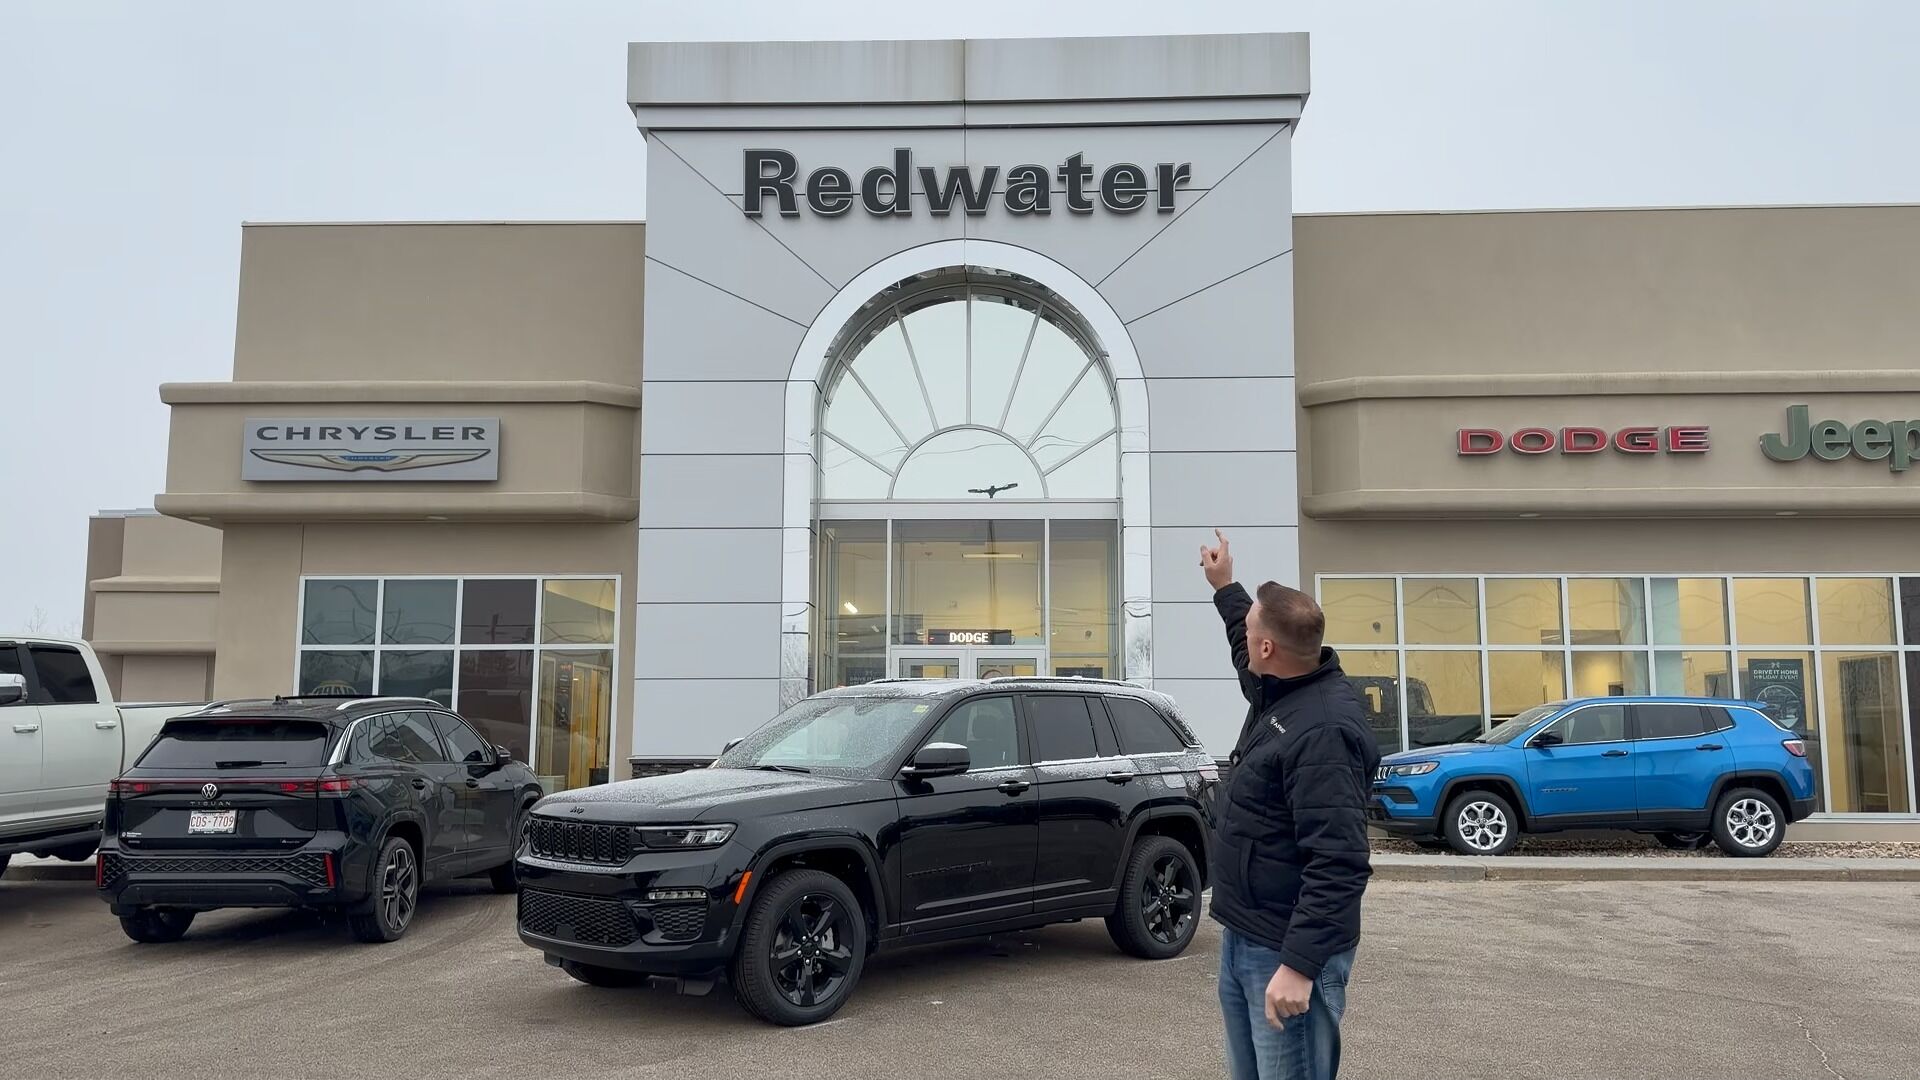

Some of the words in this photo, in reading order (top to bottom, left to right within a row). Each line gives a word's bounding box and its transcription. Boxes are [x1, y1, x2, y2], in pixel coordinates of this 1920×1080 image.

[743, 148, 1191, 217] Redwater
[256, 426, 486, 441] CHRYSLER
[1456, 426, 1711, 455] DODGE
[1760, 405, 1920, 472] Jeep
[949, 632, 989, 643] DODGE
[190, 816, 235, 828] CDS-7709
